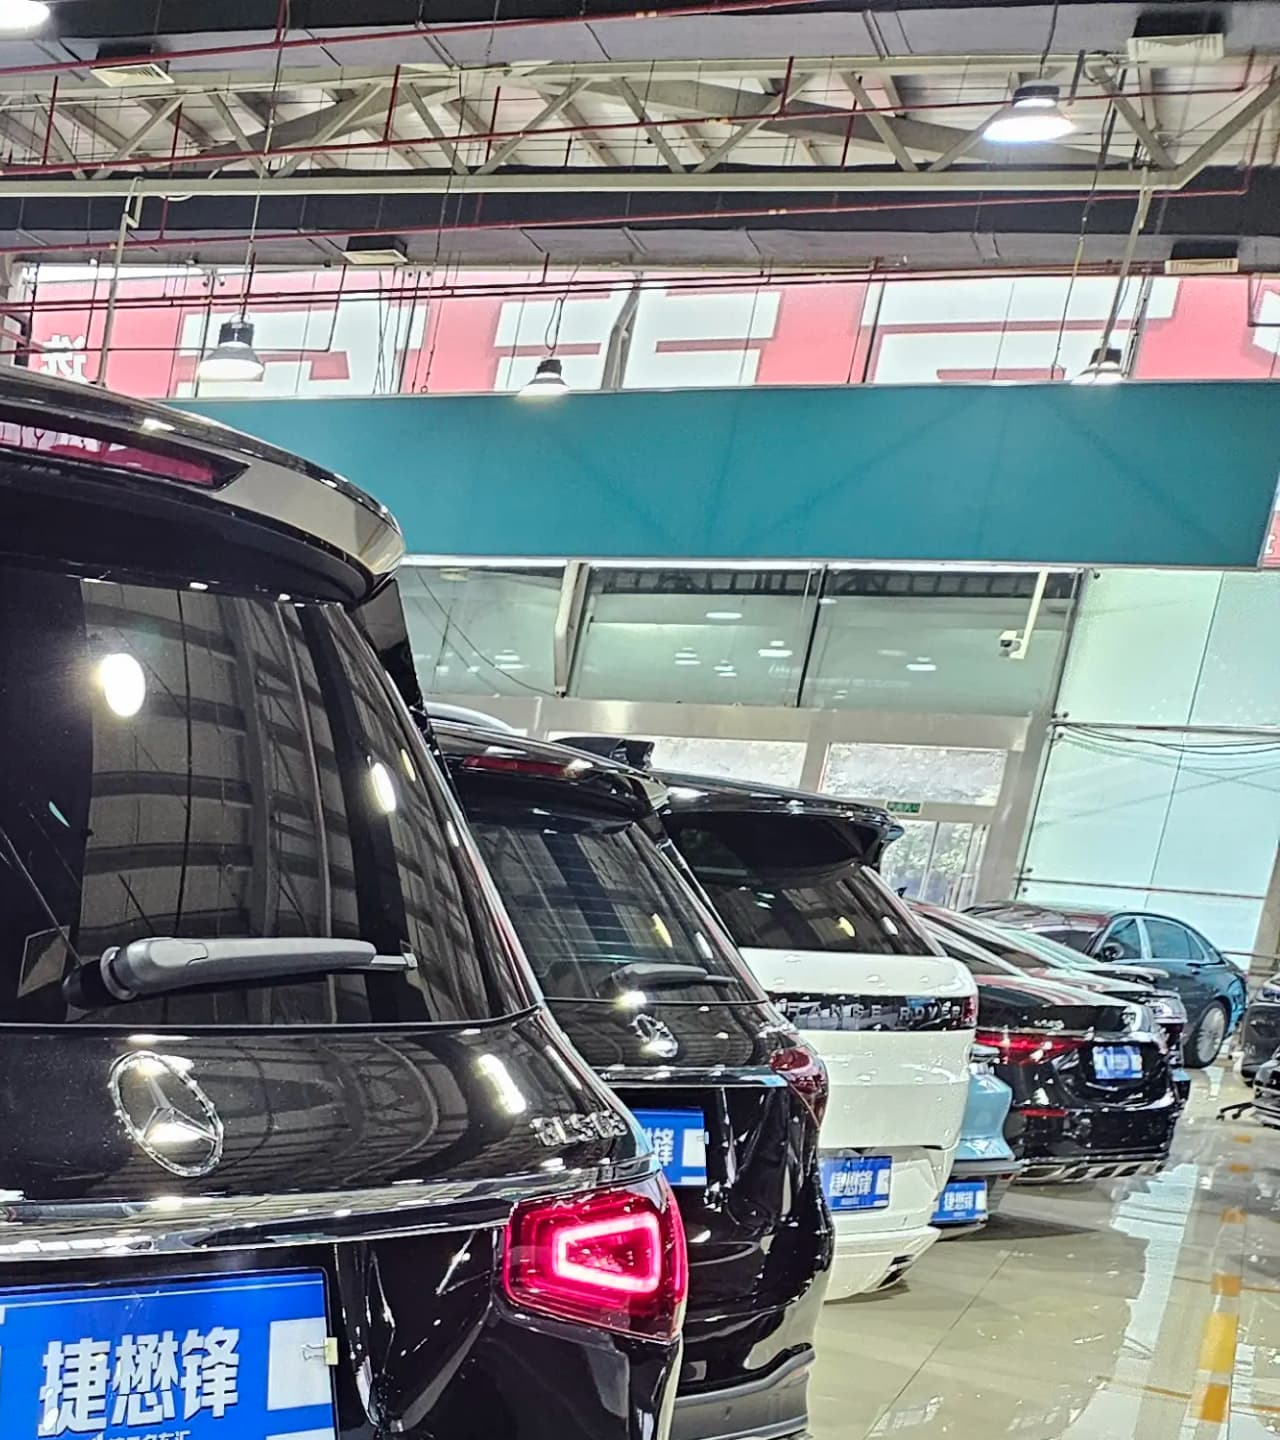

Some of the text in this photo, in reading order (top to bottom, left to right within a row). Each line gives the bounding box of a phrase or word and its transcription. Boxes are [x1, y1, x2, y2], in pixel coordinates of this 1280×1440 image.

[785, 1002, 962, 1021] RANGE ROVER
[37, 1326, 240, 1438] 捷懋锋
